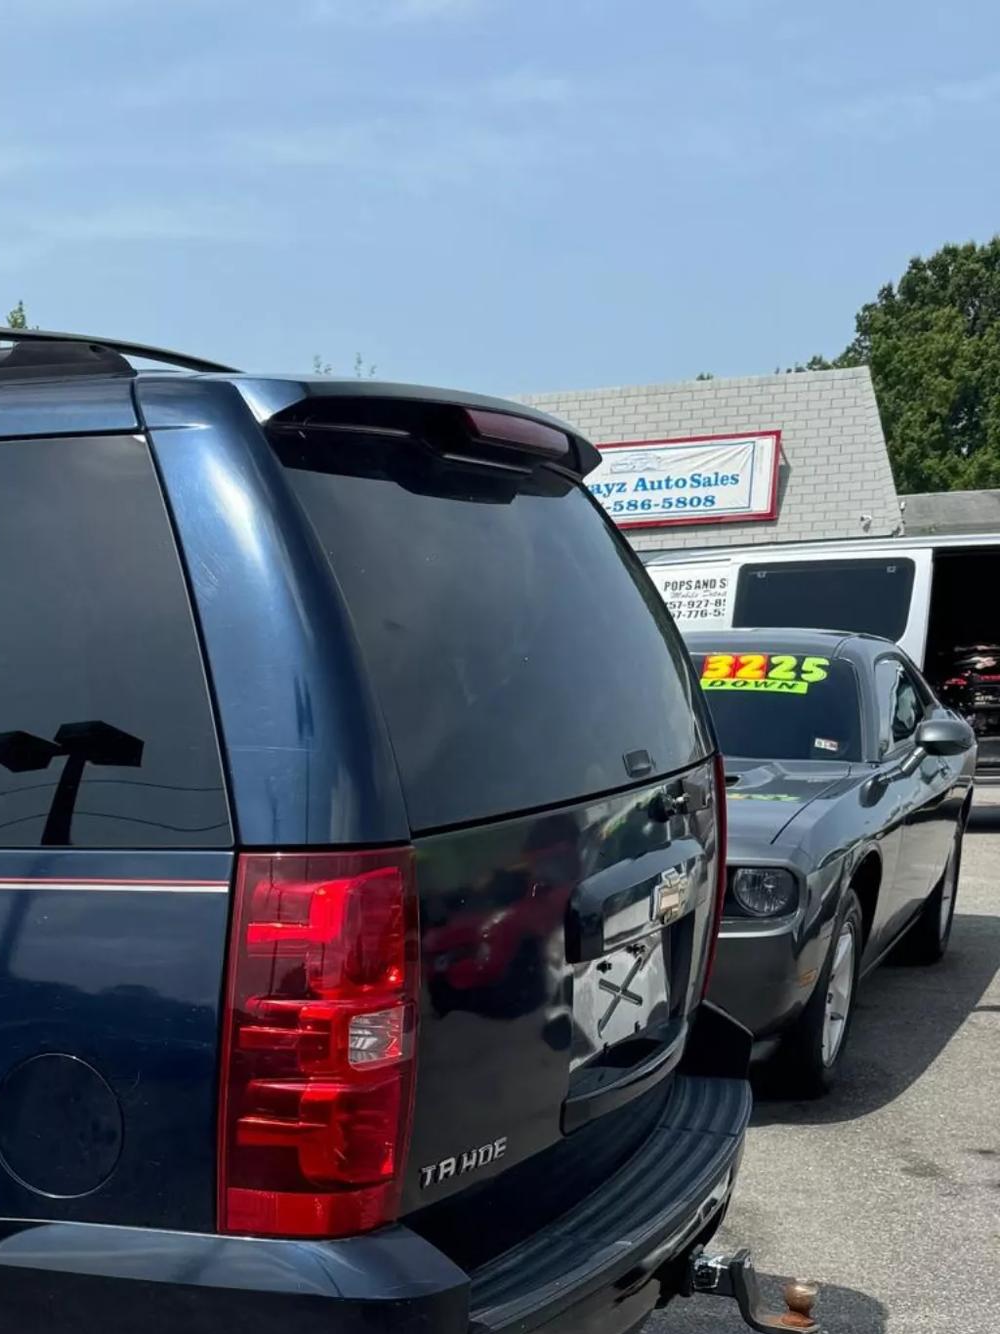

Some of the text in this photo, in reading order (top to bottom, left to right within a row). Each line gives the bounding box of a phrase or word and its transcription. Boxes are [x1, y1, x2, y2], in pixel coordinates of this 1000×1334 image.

[588, 472, 740, 498] ayz Auto Sales
[602, 495, 716, 512] -586-5808
[664, 578, 728, 591] POPS AND S
[702, 654, 830, 683] 3225
[707, 680, 799, 690] DOWN
[420, 1136, 508, 1189] TAHOE
